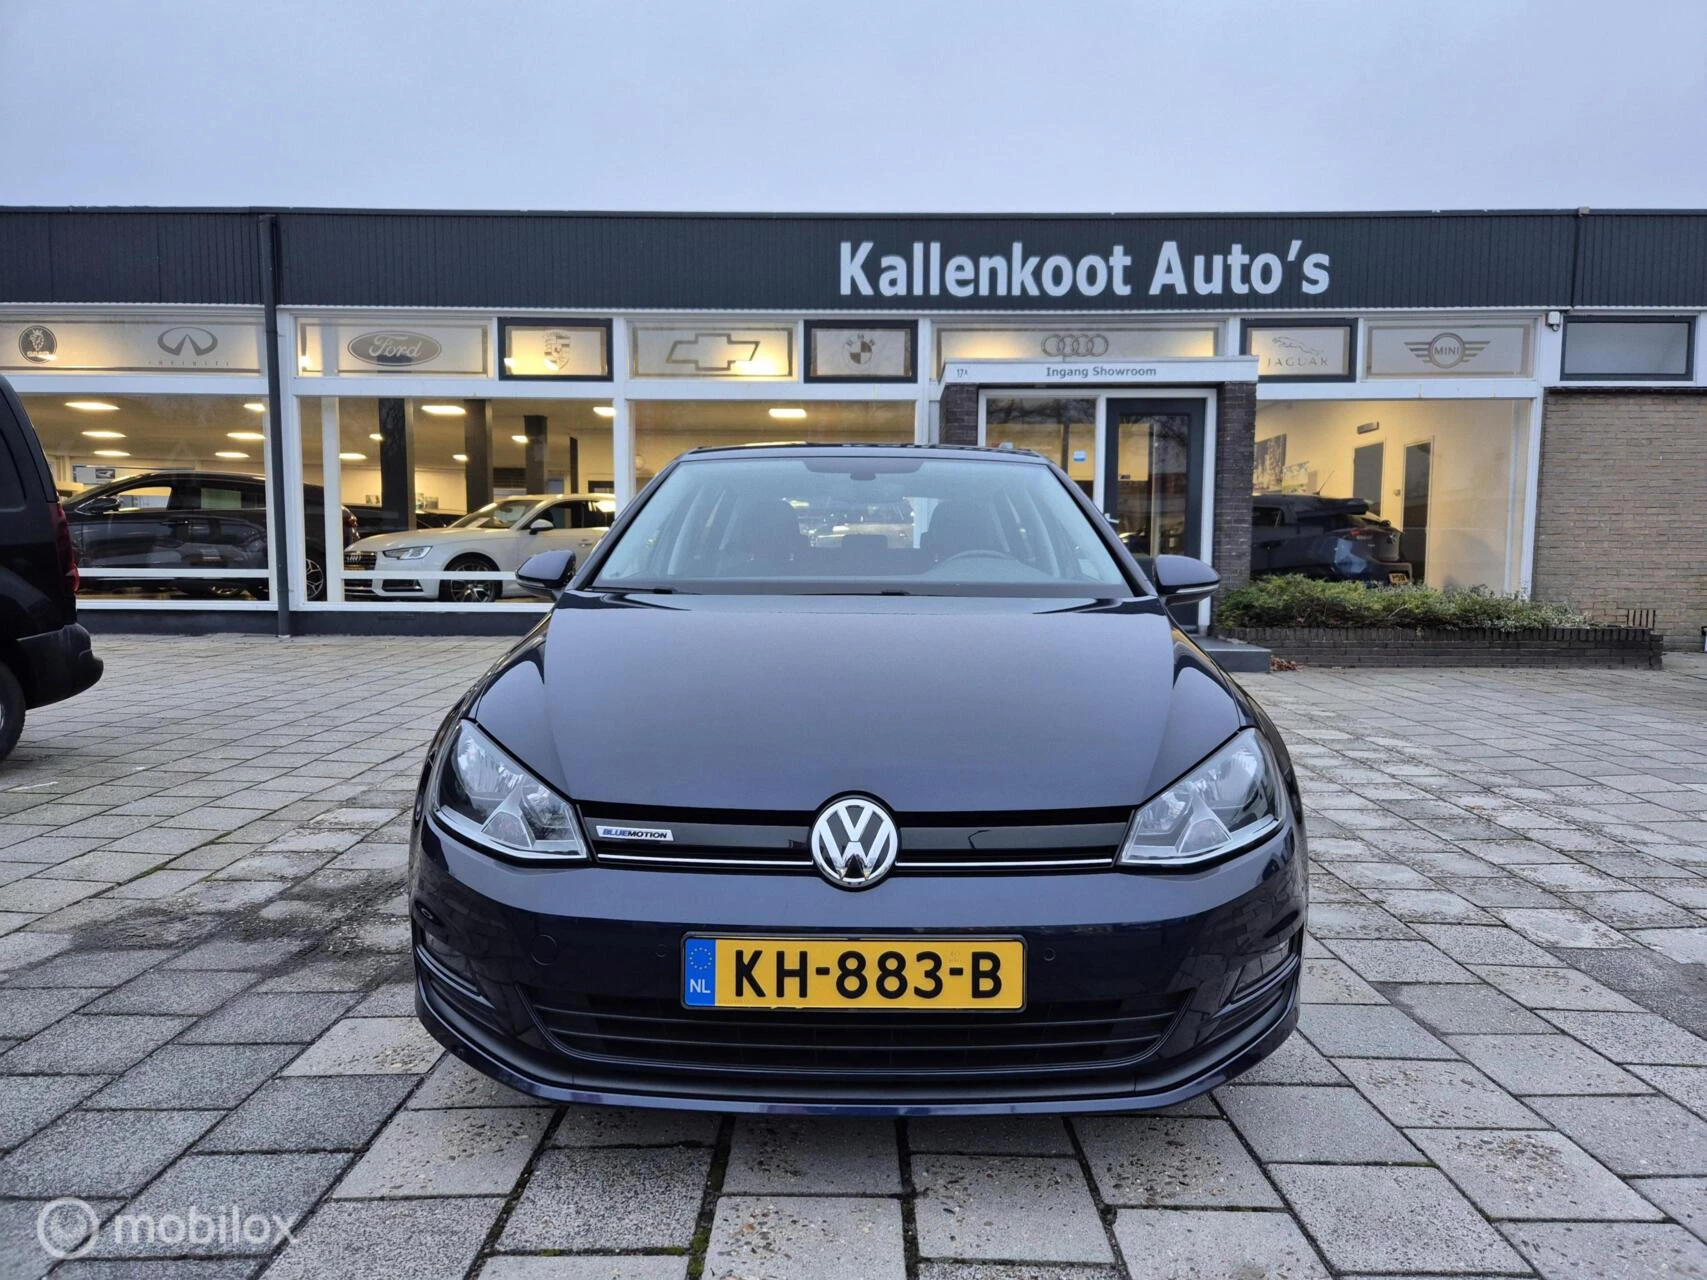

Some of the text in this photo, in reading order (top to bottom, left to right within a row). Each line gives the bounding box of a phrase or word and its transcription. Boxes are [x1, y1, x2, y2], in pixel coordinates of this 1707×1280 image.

[839, 240, 1132, 298] Kallenkoot
[368, 335, 422, 357] Ford
[1434, 345, 1460, 356] MINI
[1046, 366, 1157, 379] Ingang Showroom
[602, 828, 668, 839] BLUEMOTION
[734, 950, 1003, 1000] KH-883-B
[689, 978, 711, 994] NL
